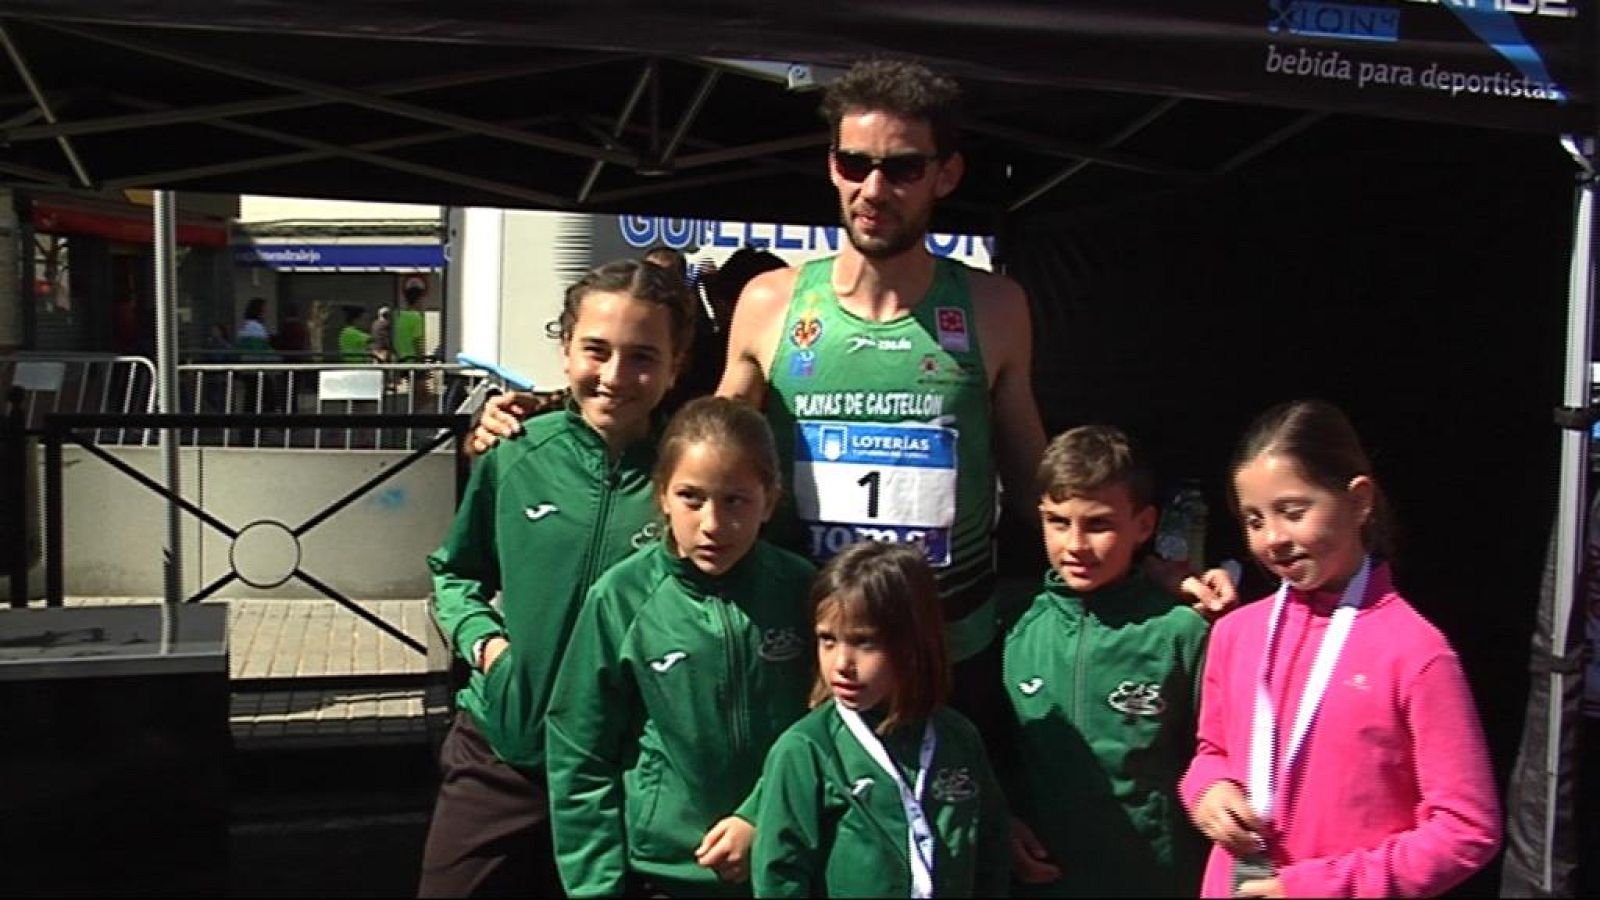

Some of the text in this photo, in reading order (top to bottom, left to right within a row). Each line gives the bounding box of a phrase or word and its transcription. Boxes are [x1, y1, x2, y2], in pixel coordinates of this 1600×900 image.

[1265, 45, 1560, 100] bebida para deportistas
[794, 393, 842, 416] PLAYAS
[845, 393, 864, 416] DE
[857, 470, 881, 519] 1
